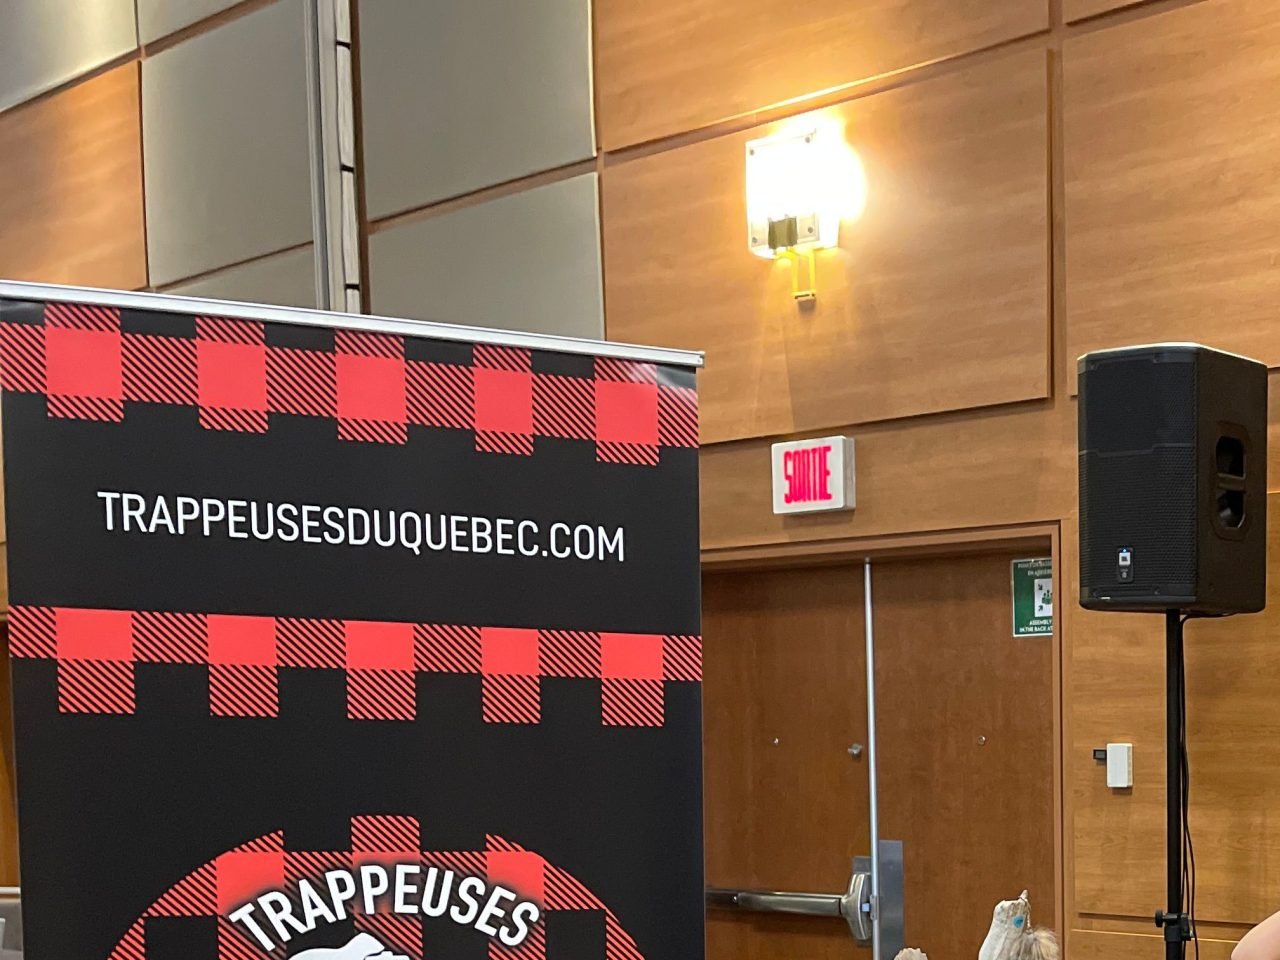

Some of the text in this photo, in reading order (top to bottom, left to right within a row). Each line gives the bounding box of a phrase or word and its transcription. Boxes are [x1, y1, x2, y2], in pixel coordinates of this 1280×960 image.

[784, 446, 832, 504] SORTIE
[97, 491, 625, 561] TRAPPEUSESDUQUEBEC.COM
[228, 863, 540, 952] TRAPPEUSES
